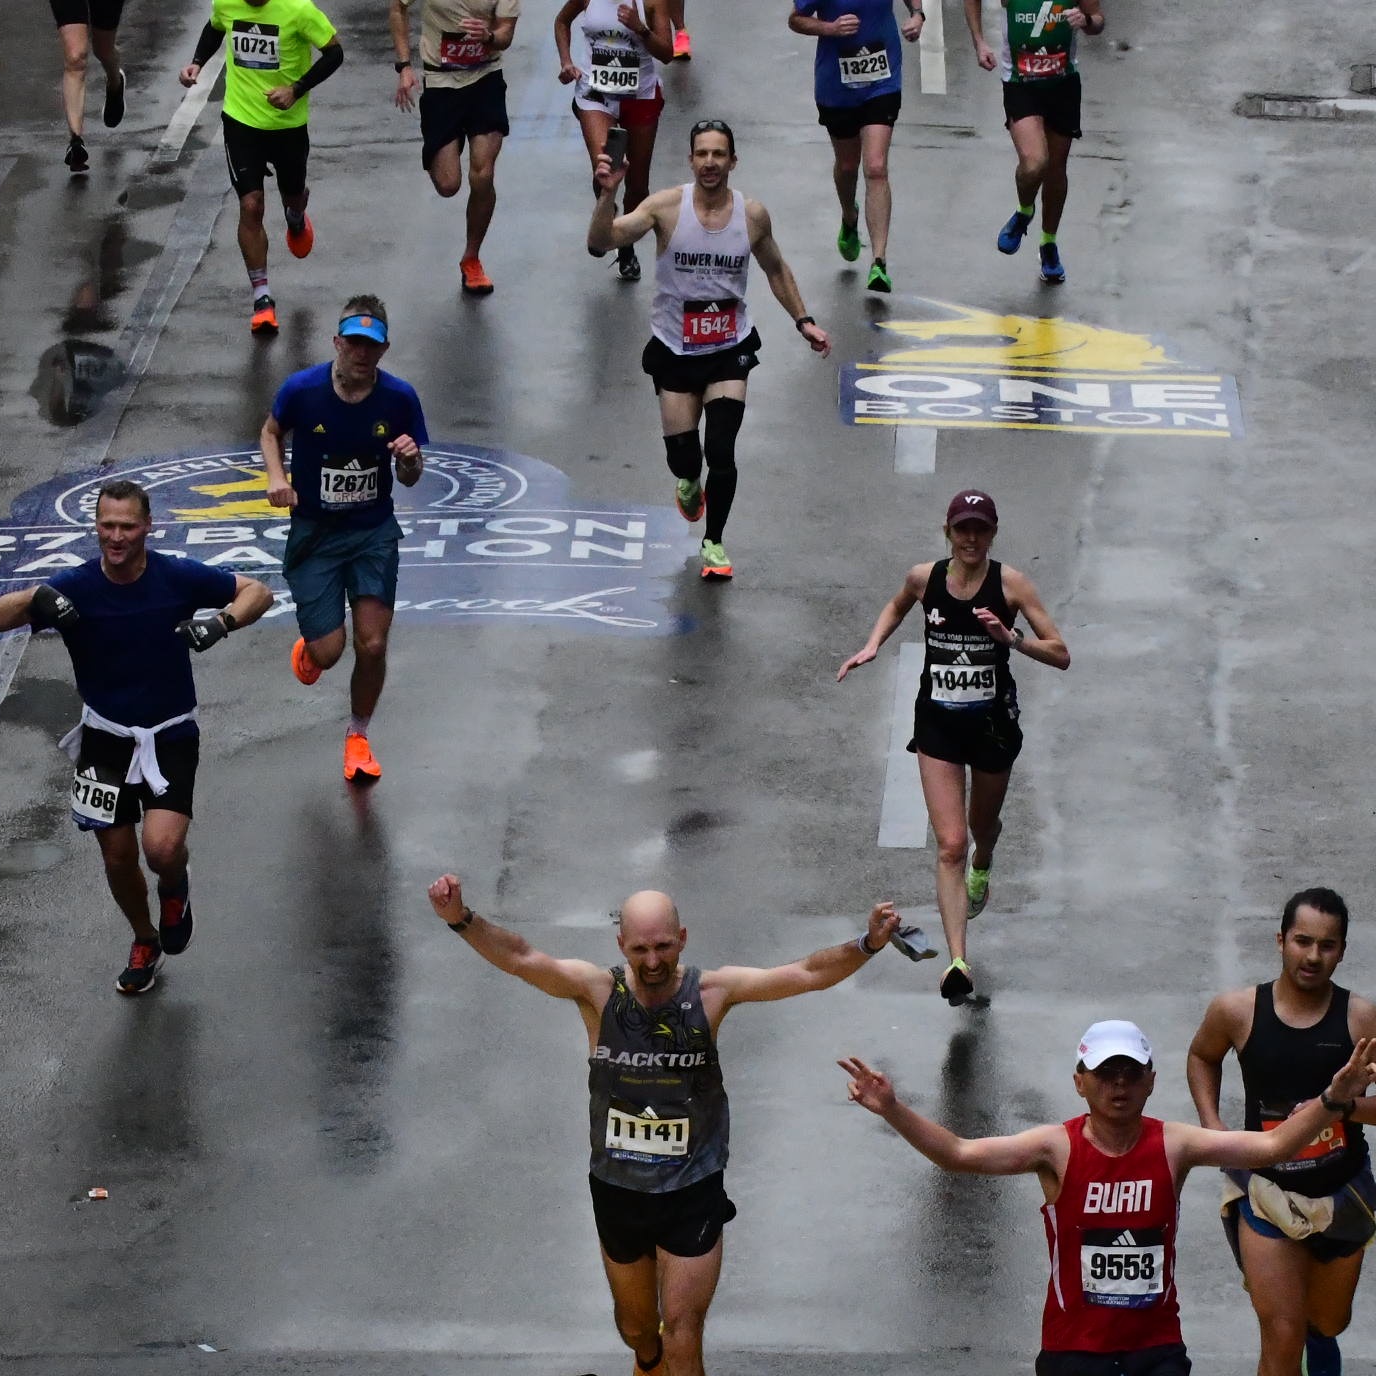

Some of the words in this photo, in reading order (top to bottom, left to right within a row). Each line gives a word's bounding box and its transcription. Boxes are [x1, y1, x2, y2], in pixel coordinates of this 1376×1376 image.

[232, 36, 275, 55] 10721
[841, 54, 888, 75] 13229
[592, 69, 638, 87] 13405
[674, 252, 712, 267] POWER
[690, 314, 730, 335] 1542
[854, 374, 1222, 410] ONE
[855, 400, 1229, 428] BOSTON
[323, 472, 376, 493] 12670
[933, 670, 994, 690] 10449
[611, 1117, 683, 1142] 11141
[1083, 1179, 1153, 1214] BURN
[1091, 1252, 1155, 1281] 9553
